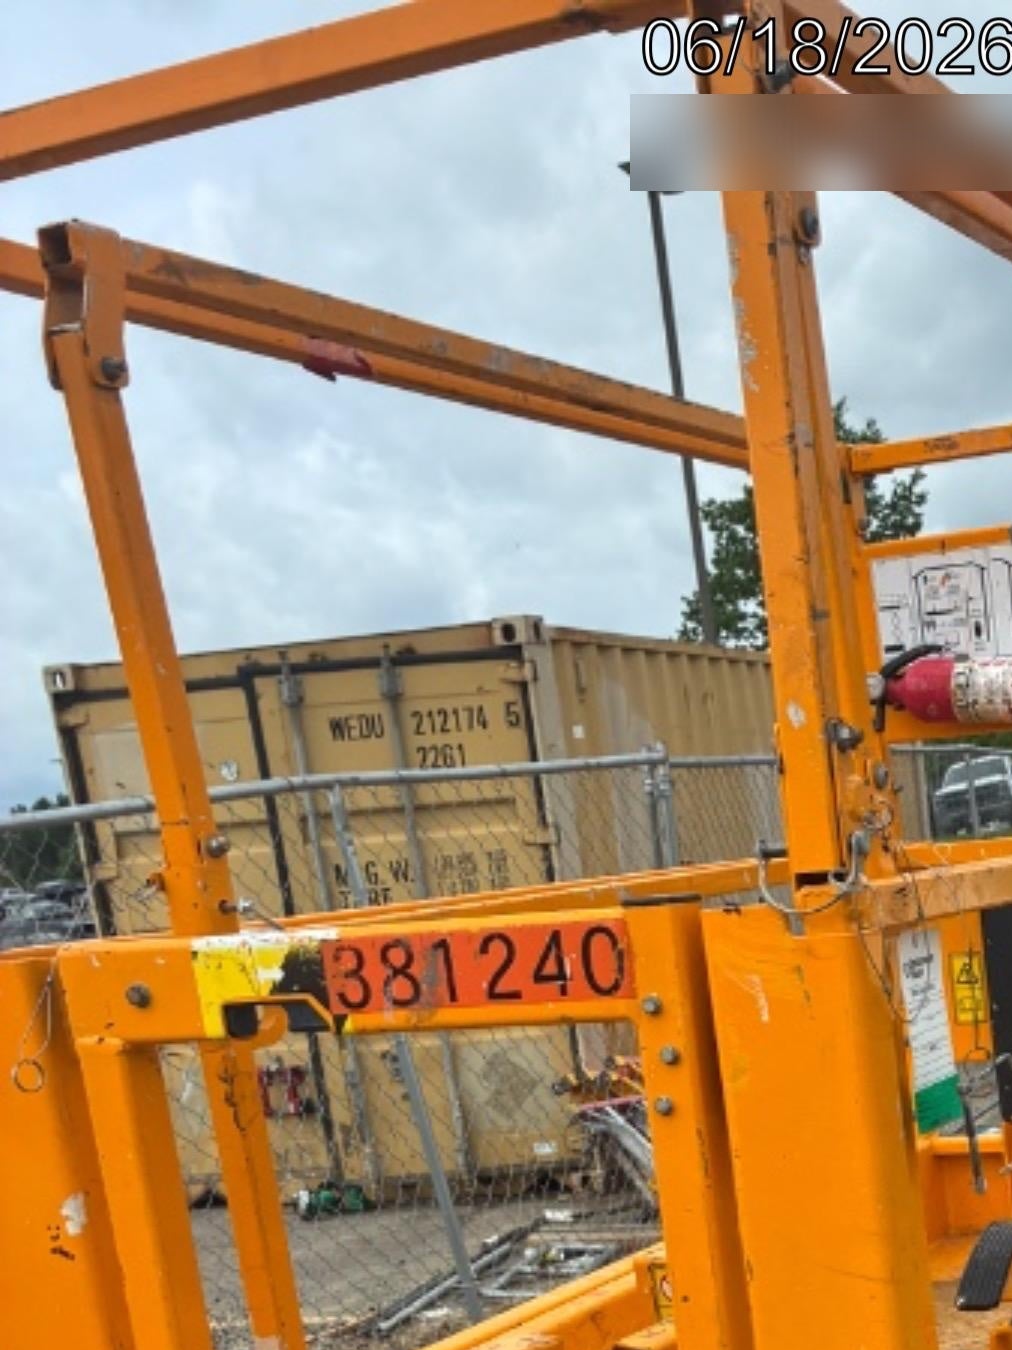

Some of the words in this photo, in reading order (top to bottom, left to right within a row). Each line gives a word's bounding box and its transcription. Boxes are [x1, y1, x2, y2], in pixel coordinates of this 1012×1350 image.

[329, 713, 385, 741] WEDU
[411, 704, 488, 735] 212174
[504, 702, 521, 728] 5
[333, 927, 625, 1010] 381240
